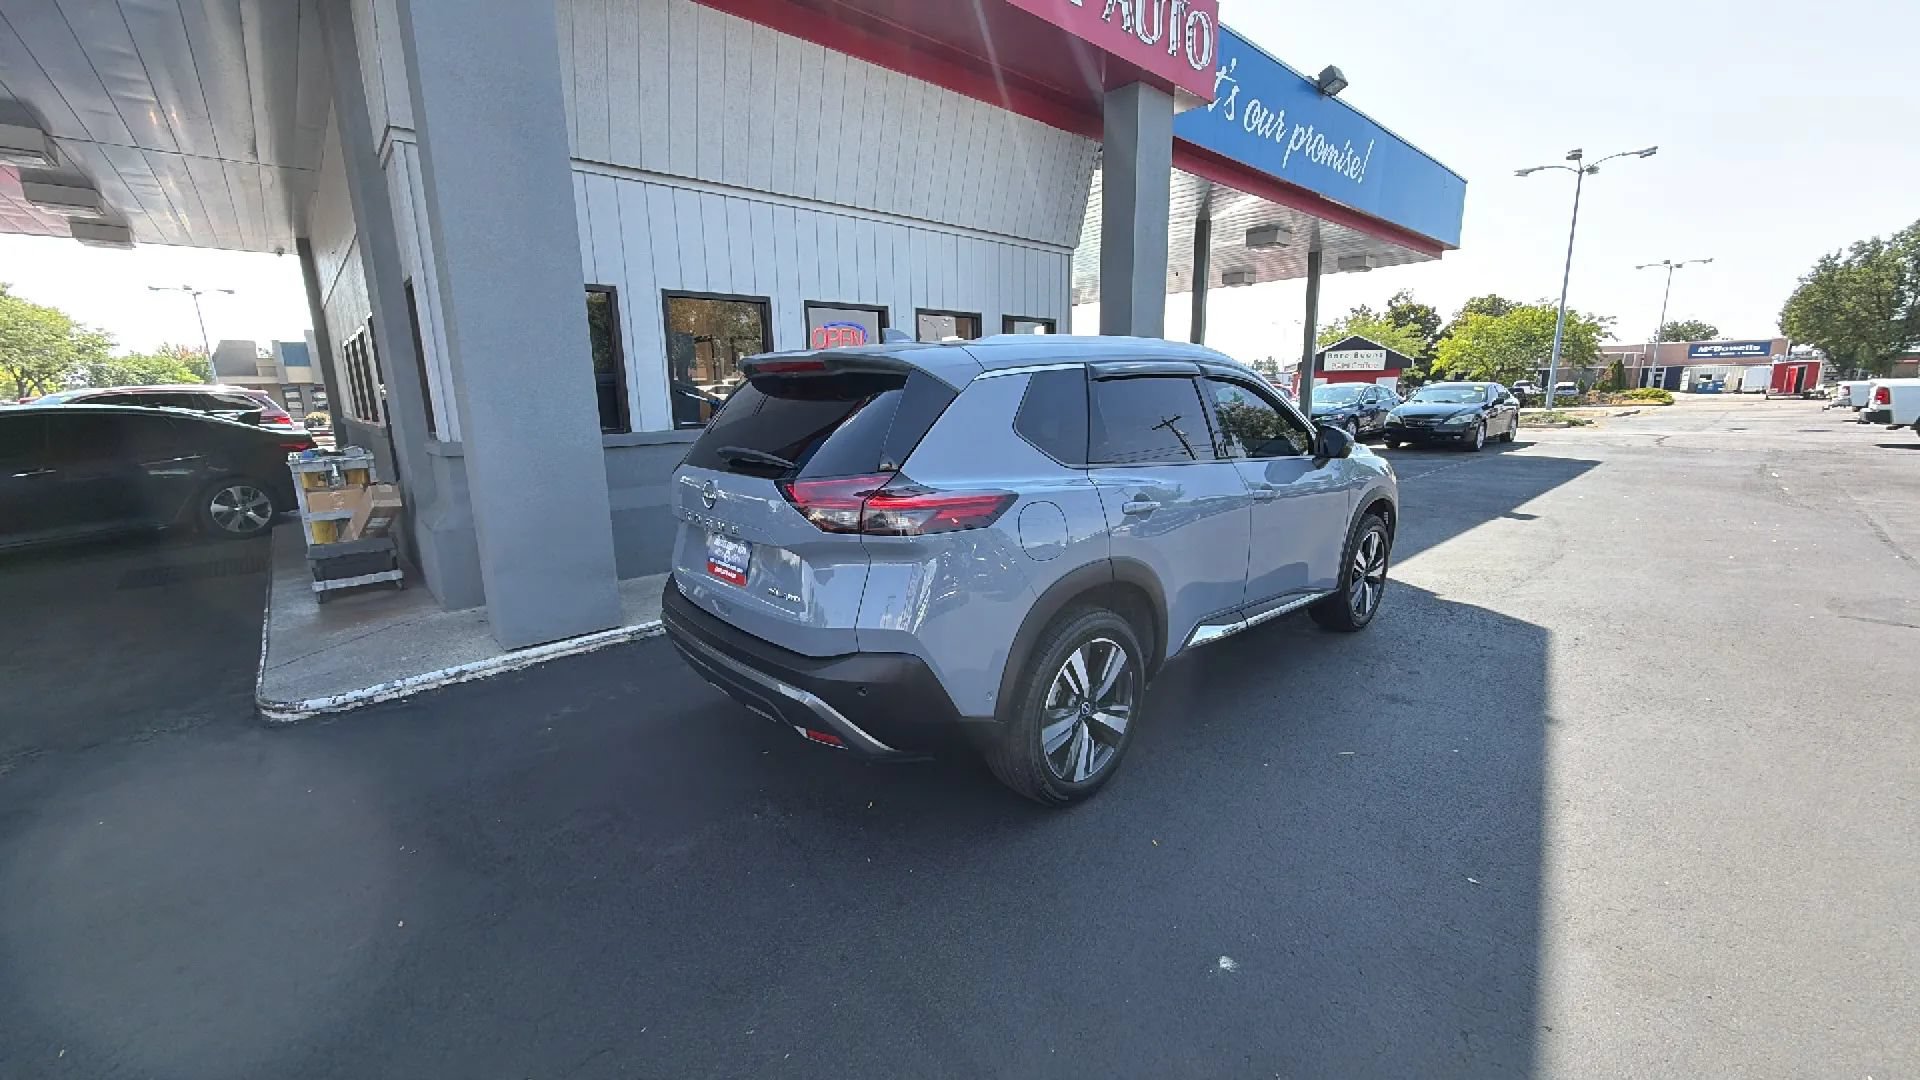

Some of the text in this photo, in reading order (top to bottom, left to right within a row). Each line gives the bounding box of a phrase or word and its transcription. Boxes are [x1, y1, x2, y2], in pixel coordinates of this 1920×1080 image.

[1207, 57, 1375, 184] t's our promise!
[812, 326, 865, 350] OPEN
